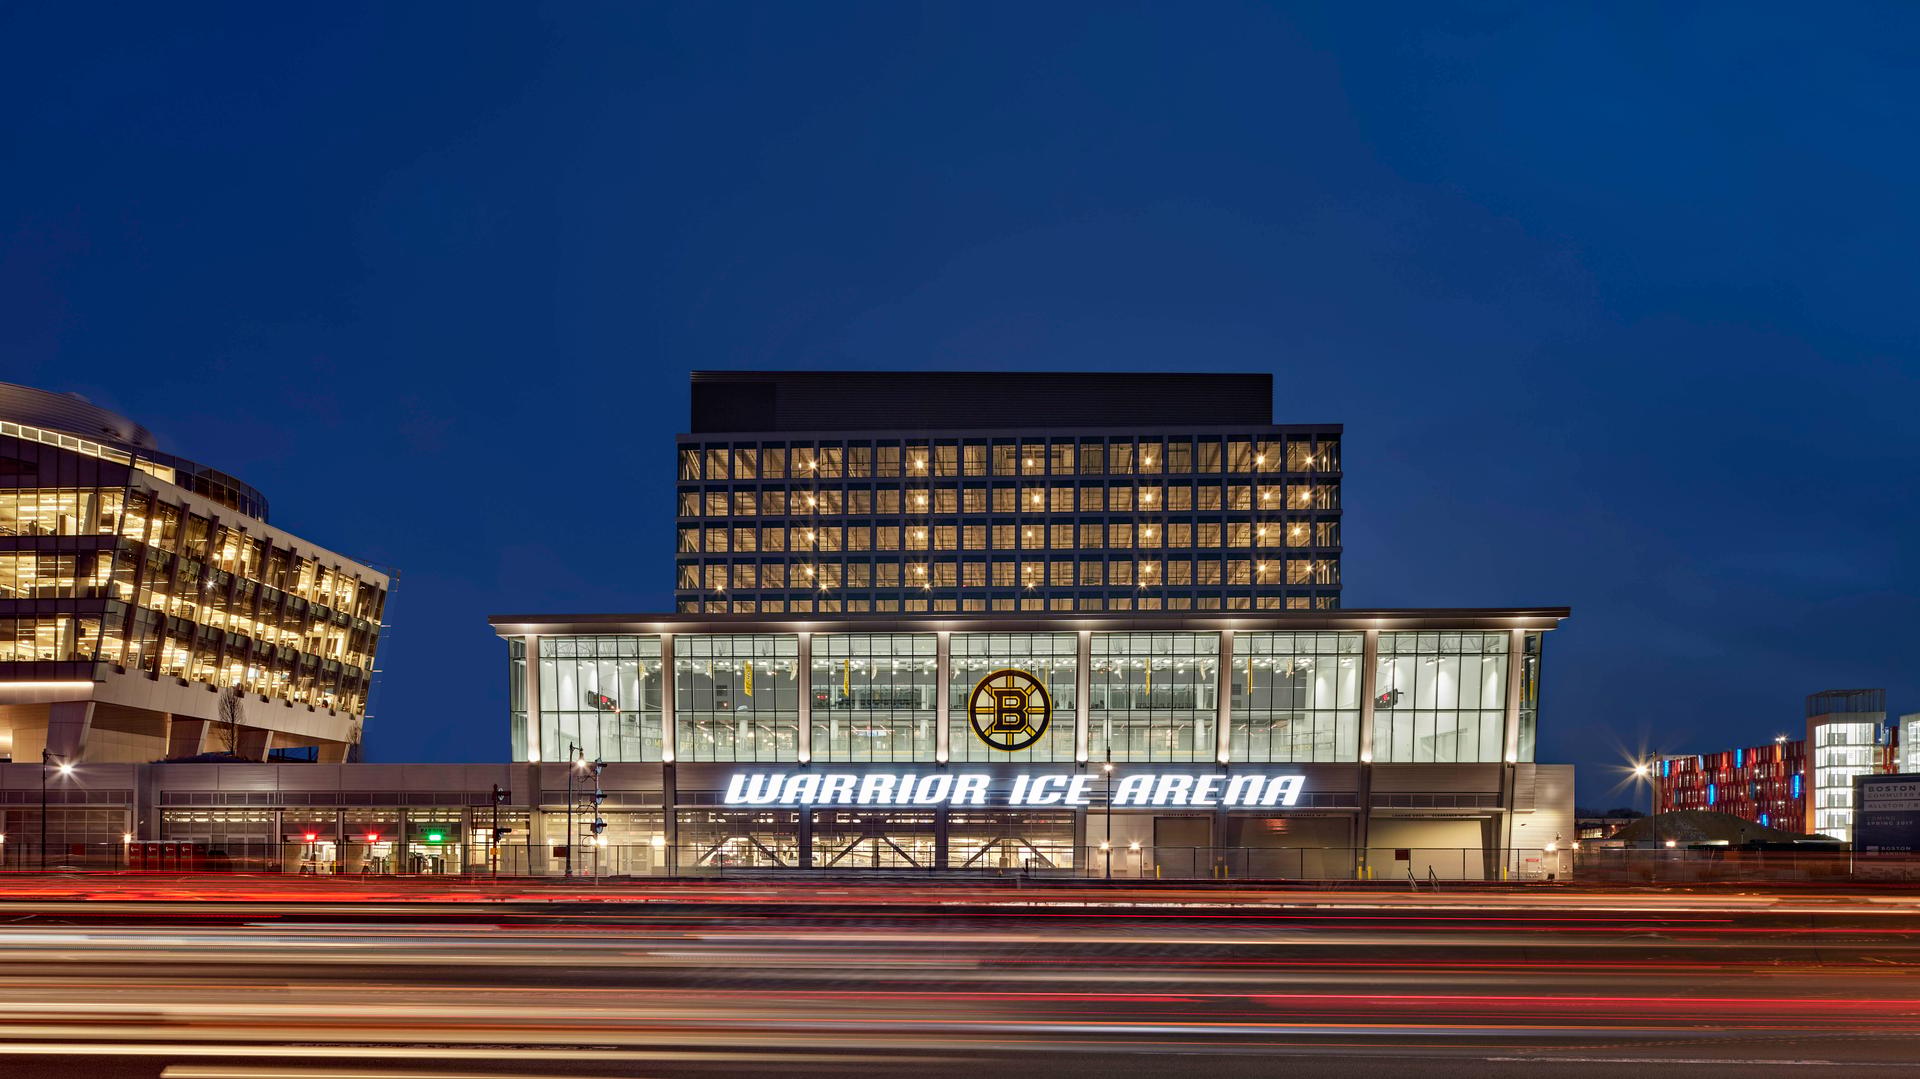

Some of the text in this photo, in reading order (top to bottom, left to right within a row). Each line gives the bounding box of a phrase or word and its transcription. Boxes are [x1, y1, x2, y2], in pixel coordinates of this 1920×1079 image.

[724, 774, 1306, 806] WARRIOR ICE ARENA
